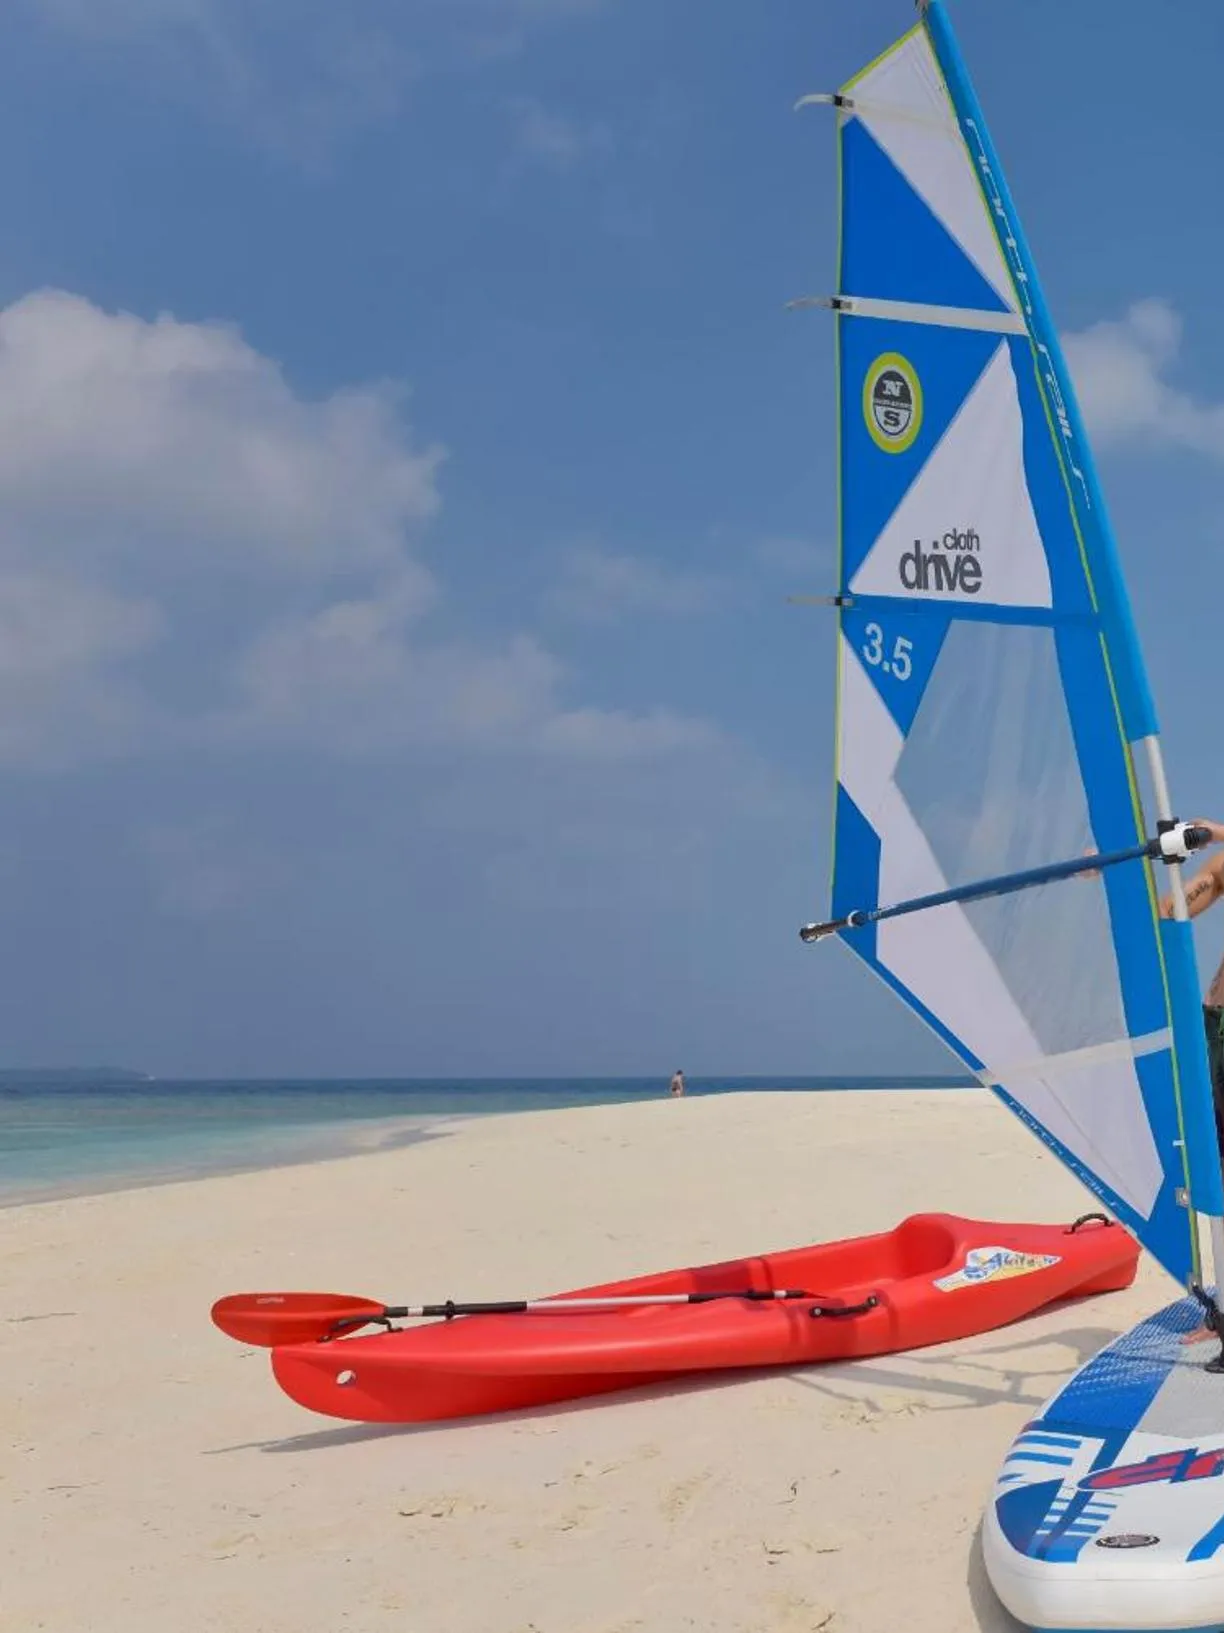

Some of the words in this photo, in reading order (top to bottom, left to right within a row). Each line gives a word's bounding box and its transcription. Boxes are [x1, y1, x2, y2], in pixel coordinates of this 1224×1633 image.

[882, 380, 904, 397] N
[883, 410, 900, 427] S
[943, 528, 980, 551] cloth
[900, 539, 982, 594] drive
[862, 622, 913, 681] 3.5
